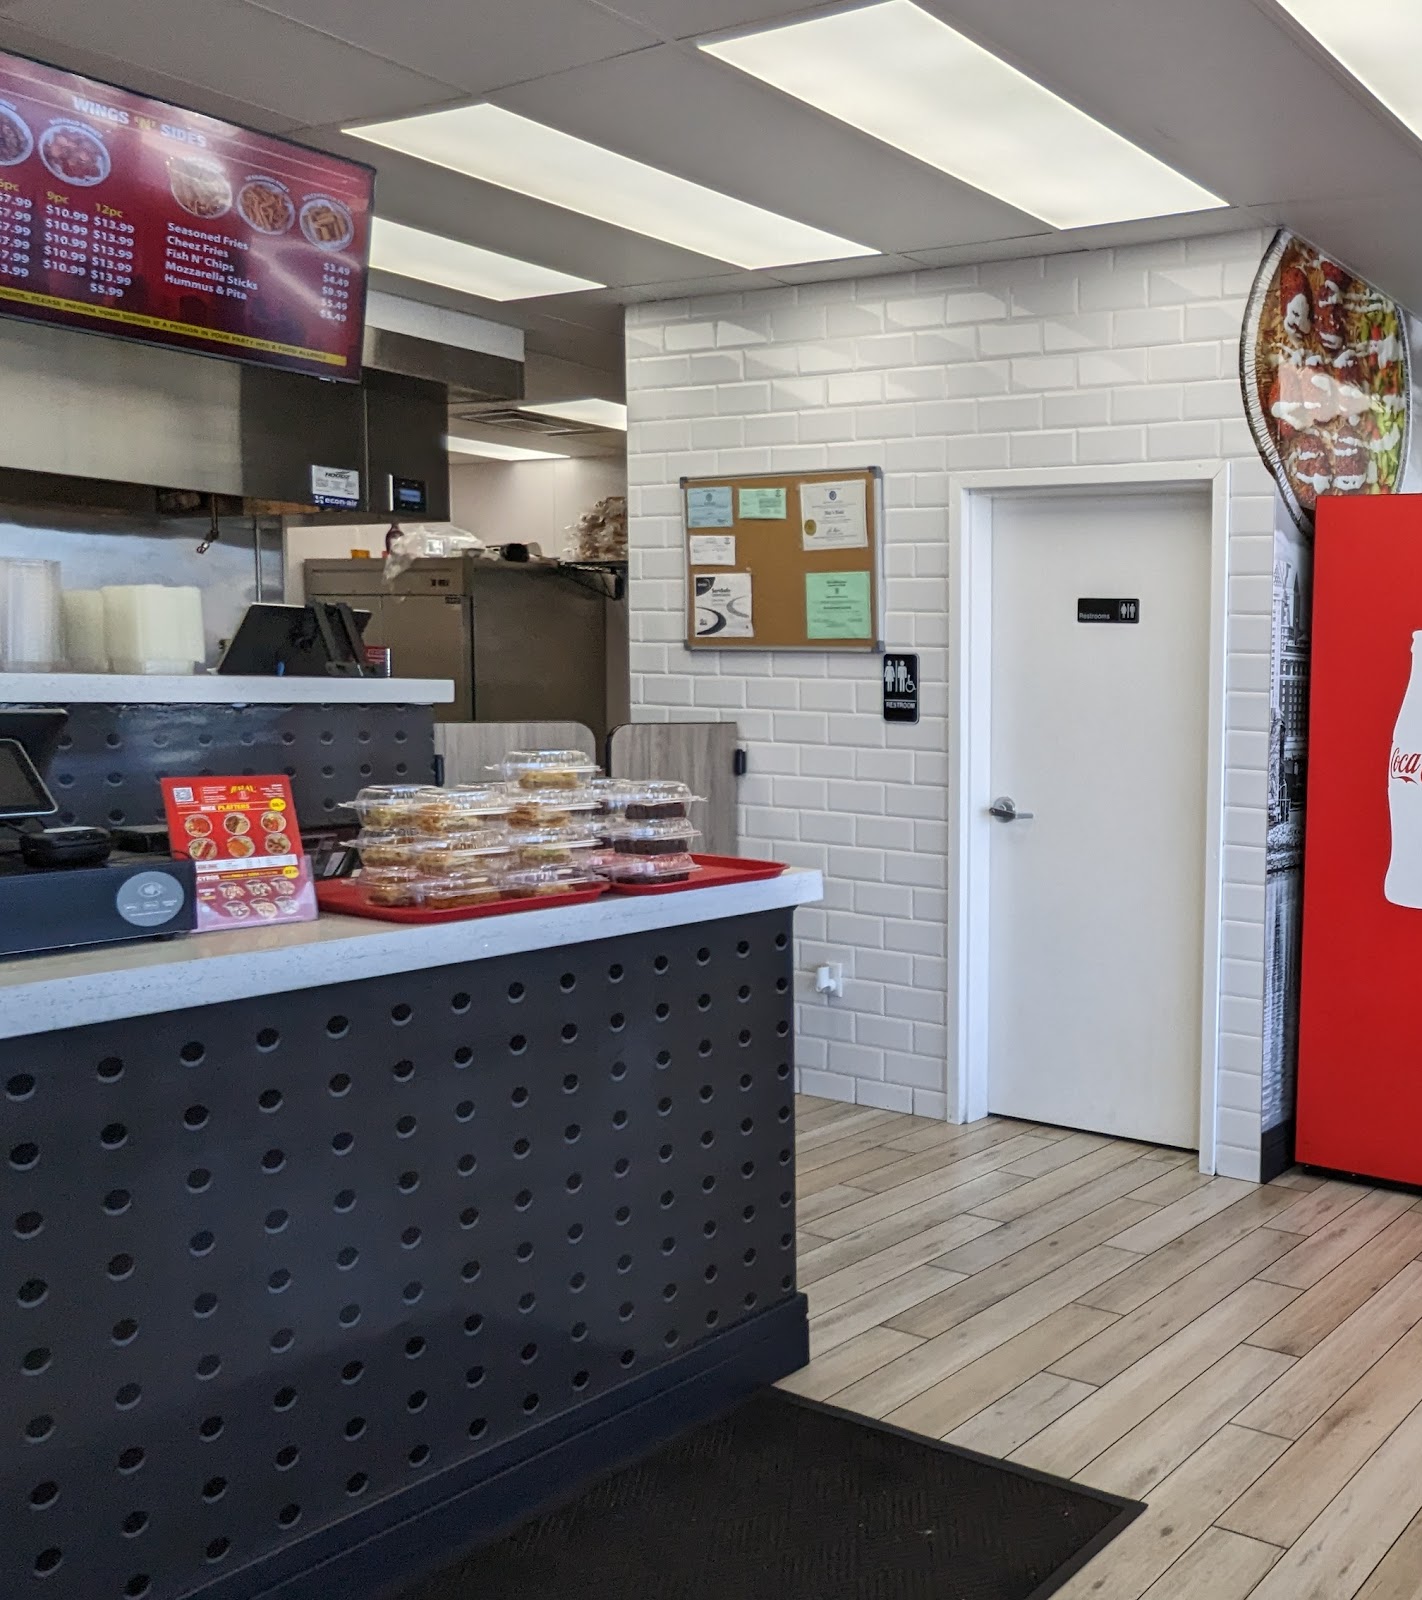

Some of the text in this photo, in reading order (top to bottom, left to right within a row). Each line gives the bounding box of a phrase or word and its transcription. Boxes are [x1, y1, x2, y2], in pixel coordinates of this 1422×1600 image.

[72, 95, 129, 125] WINGS
[160, 123, 207, 148] SIDES
[46, 190, 70, 204] 9pc
[46, 204, 88, 222] $10.99
[95, 202, 124, 218] 12pc
[0, 221, 31, 236] 7.99
[45, 218, 88, 236] $10.99
[94, 216, 135, 234] $13.99
[0, 235, 30, 250] 7.99
[44, 231, 88, 249] $10.99
[93, 229, 134, 247] $13.99
[167, 222, 249, 251] Seasoned Fries
[43, 245, 87, 262] $10.99
[92, 243, 133, 260] $13.99
[166, 235, 229, 258] Cheez Fries
[0, 249, 30, 264] 7.99
[91, 256, 132, 273] $13.99
[166, 248, 189, 261] Fish
[204, 257, 235, 272] Chips
[0, 263, 29, 278] 3.99
[43, 259, 86, 276] $10.99
[165, 260, 258, 291] Mozzarella Sticks
[91, 269, 132, 286] $13.99
[90, 282, 124, 297] $5.99
[164, 273, 248, 300] Hummus & Pita
[211, 332, 230, 341] YOUR
[231, 335, 254, 346] PARTY
[1079, 612, 1111, 620] Restrooms
[885, 701, 916, 709] RESTROOM
